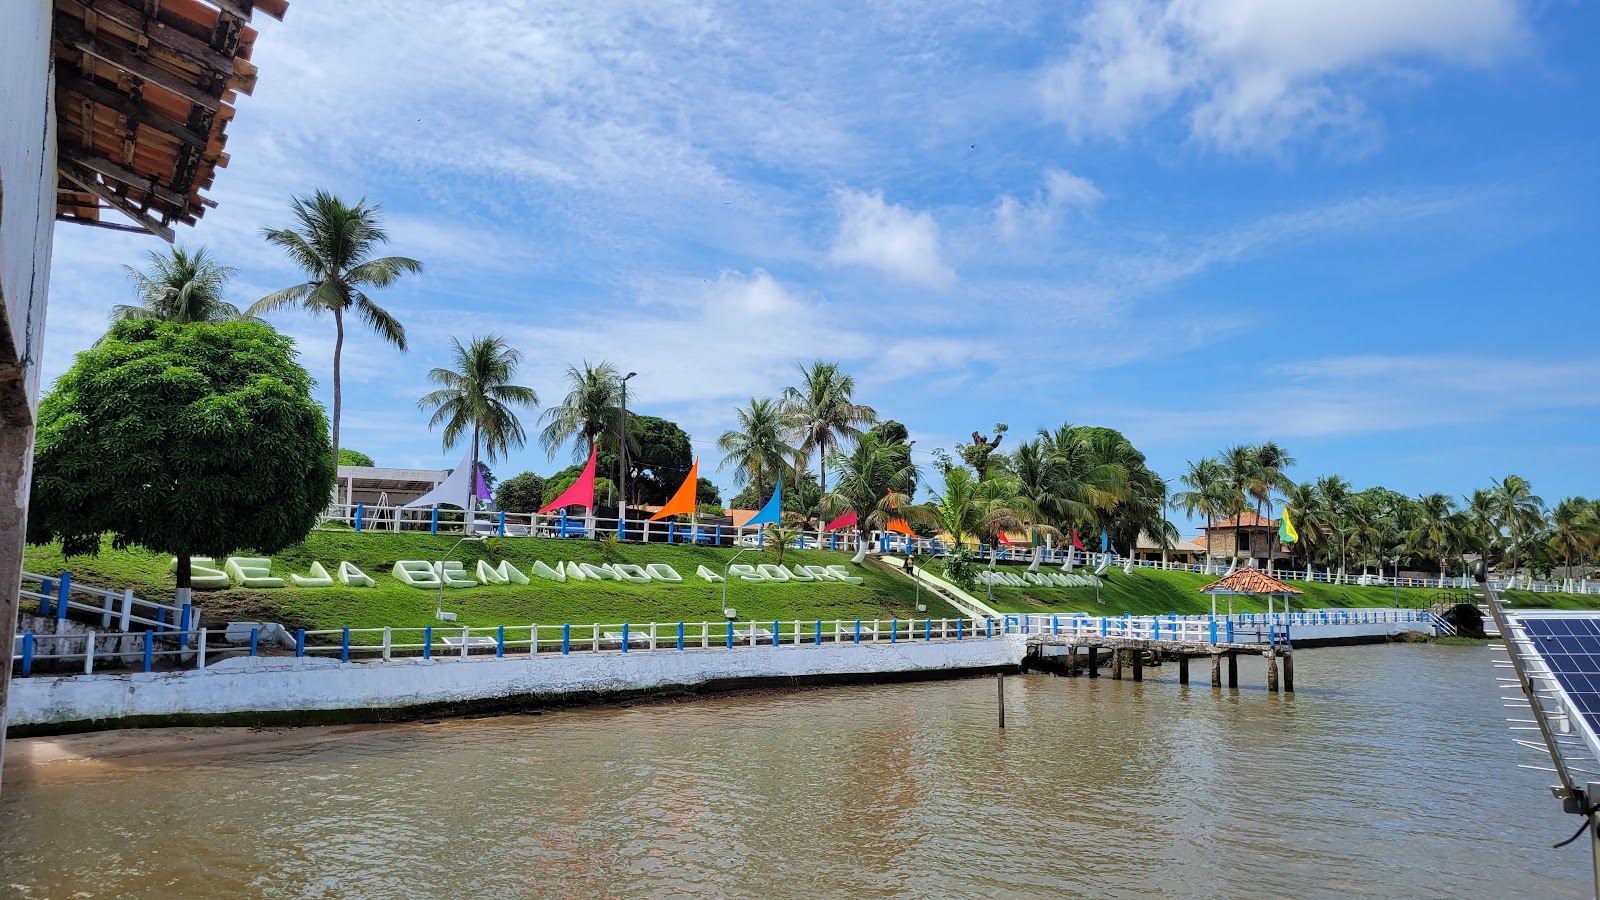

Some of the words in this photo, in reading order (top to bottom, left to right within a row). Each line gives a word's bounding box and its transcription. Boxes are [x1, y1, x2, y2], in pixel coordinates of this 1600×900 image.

[170, 556, 376, 589] SEJA
[392, 559, 530, 588] BEM
[531, 559, 683, 584] VINDO
[696, 564, 725, 584] A
[729, 563, 864, 585] SOURE
